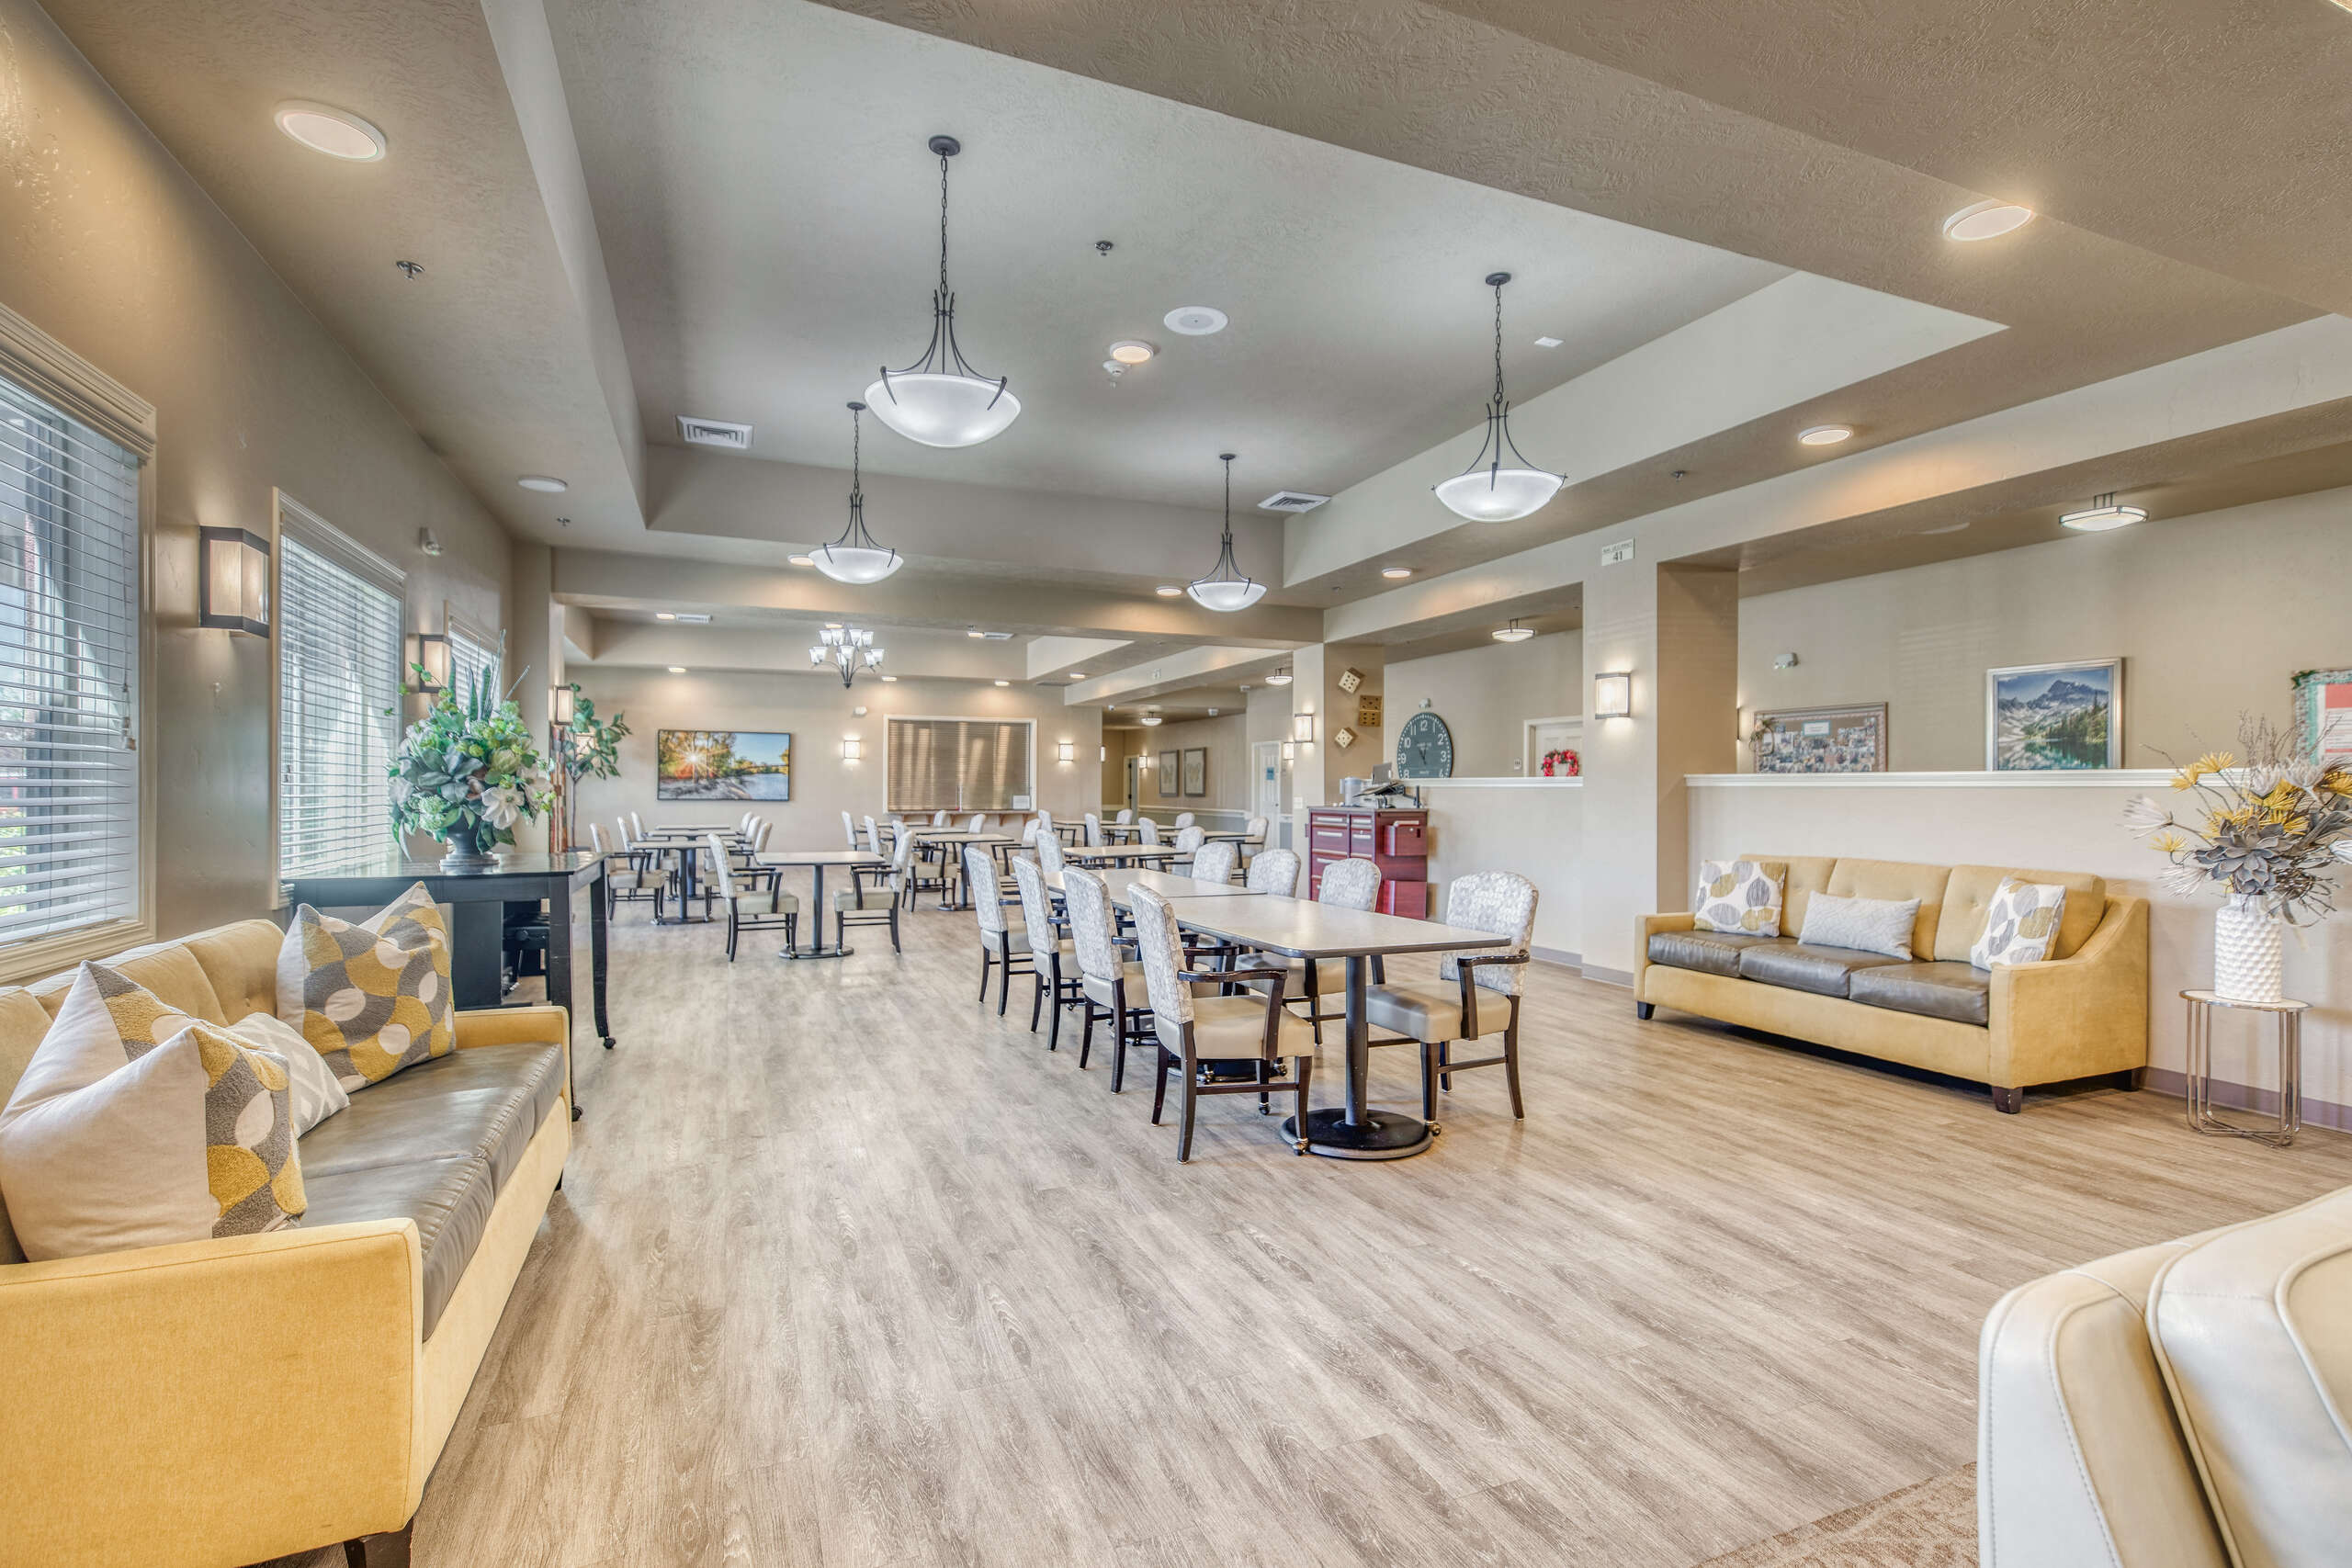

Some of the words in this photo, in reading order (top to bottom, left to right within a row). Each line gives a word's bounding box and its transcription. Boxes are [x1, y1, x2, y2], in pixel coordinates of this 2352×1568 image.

[1612, 550, 1623, 561] 41
[1410, 723, 1417, 736] 11
[1420, 719, 1428, 731] 12
[1404, 737, 1411, 749] 10
[1438, 733, 1444, 746] 2
[1400, 752, 1407, 764] 9
[1441, 750, 1447, 762] 3
[1403, 769, 1410, 779] 8
